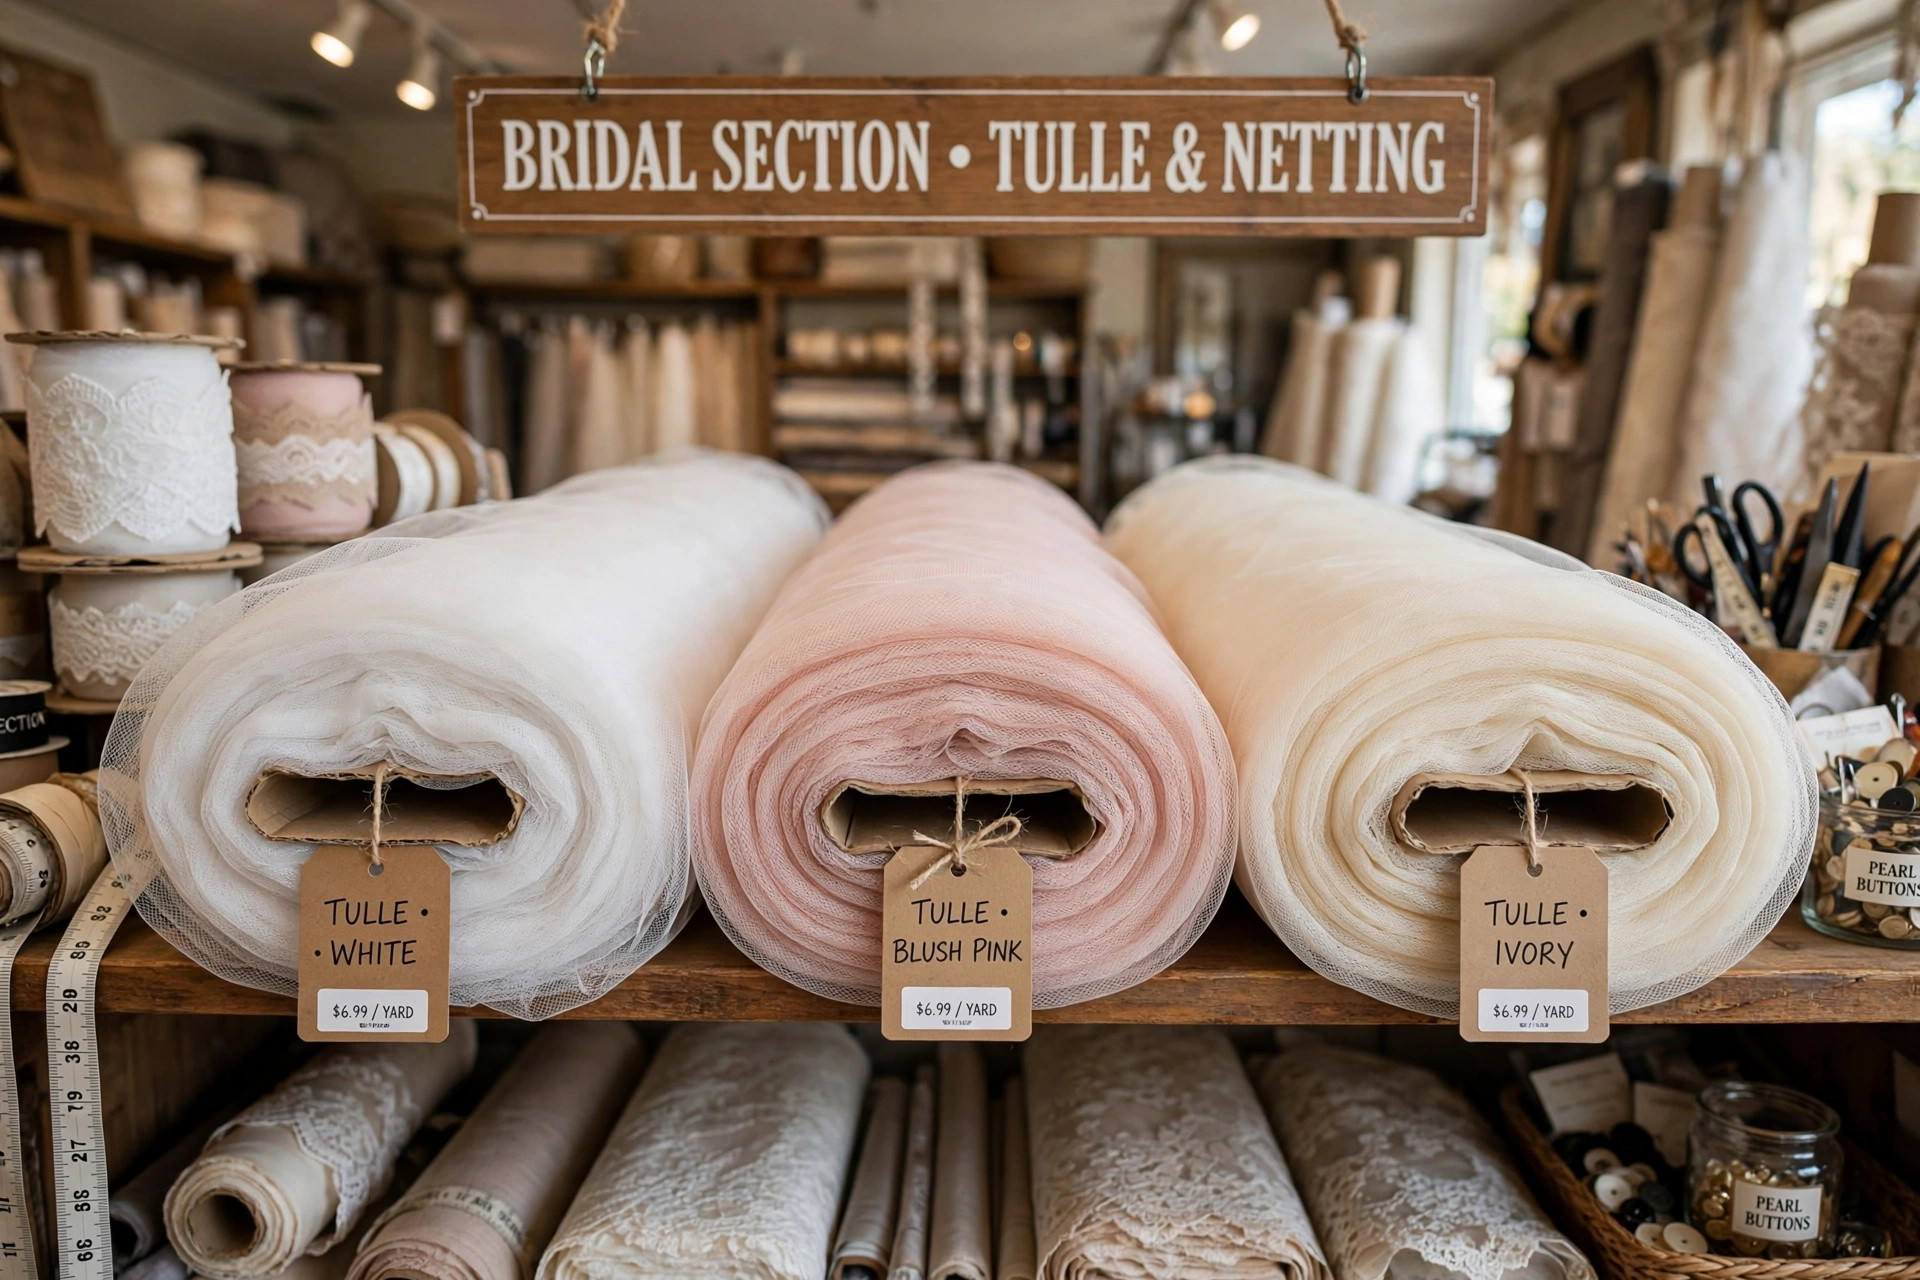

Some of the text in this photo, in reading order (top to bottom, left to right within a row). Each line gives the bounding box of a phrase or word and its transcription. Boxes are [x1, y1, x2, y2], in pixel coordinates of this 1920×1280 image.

[501, 120, 698, 192] BRIDAL
[712, 119, 931, 193] SECTION
[989, 121, 1151, 193] TULLE
[1165, 122, 1207, 193] &
[1221, 121, 1446, 194] NETTING
[1869, 861, 1917, 878] PEARL
[324, 898, 409, 926] TULLE
[911, 898, 989, 924] TULLE
[1484, 899, 1568, 926] TULLE
[331, 939, 417, 966] WHITE
[893, 938, 1023, 963] BLUSH PINK
[1496, 939, 1574, 969] IVORY
[332, 1003, 367, 1019] $6.99
[382, 1005, 414, 1019] YARD
[916, 1002, 951, 1016] $6.99
[966, 1003, 997, 1016] YARD
[1493, 1004, 1528, 1019] $6.99
[1543, 1005, 1574, 1019] YARD
[70, 1139, 87, 1162] 27
[1756, 1195, 1803, 1213] PEARL
[1745, 1211, 1811, 1231] BUTTONS
